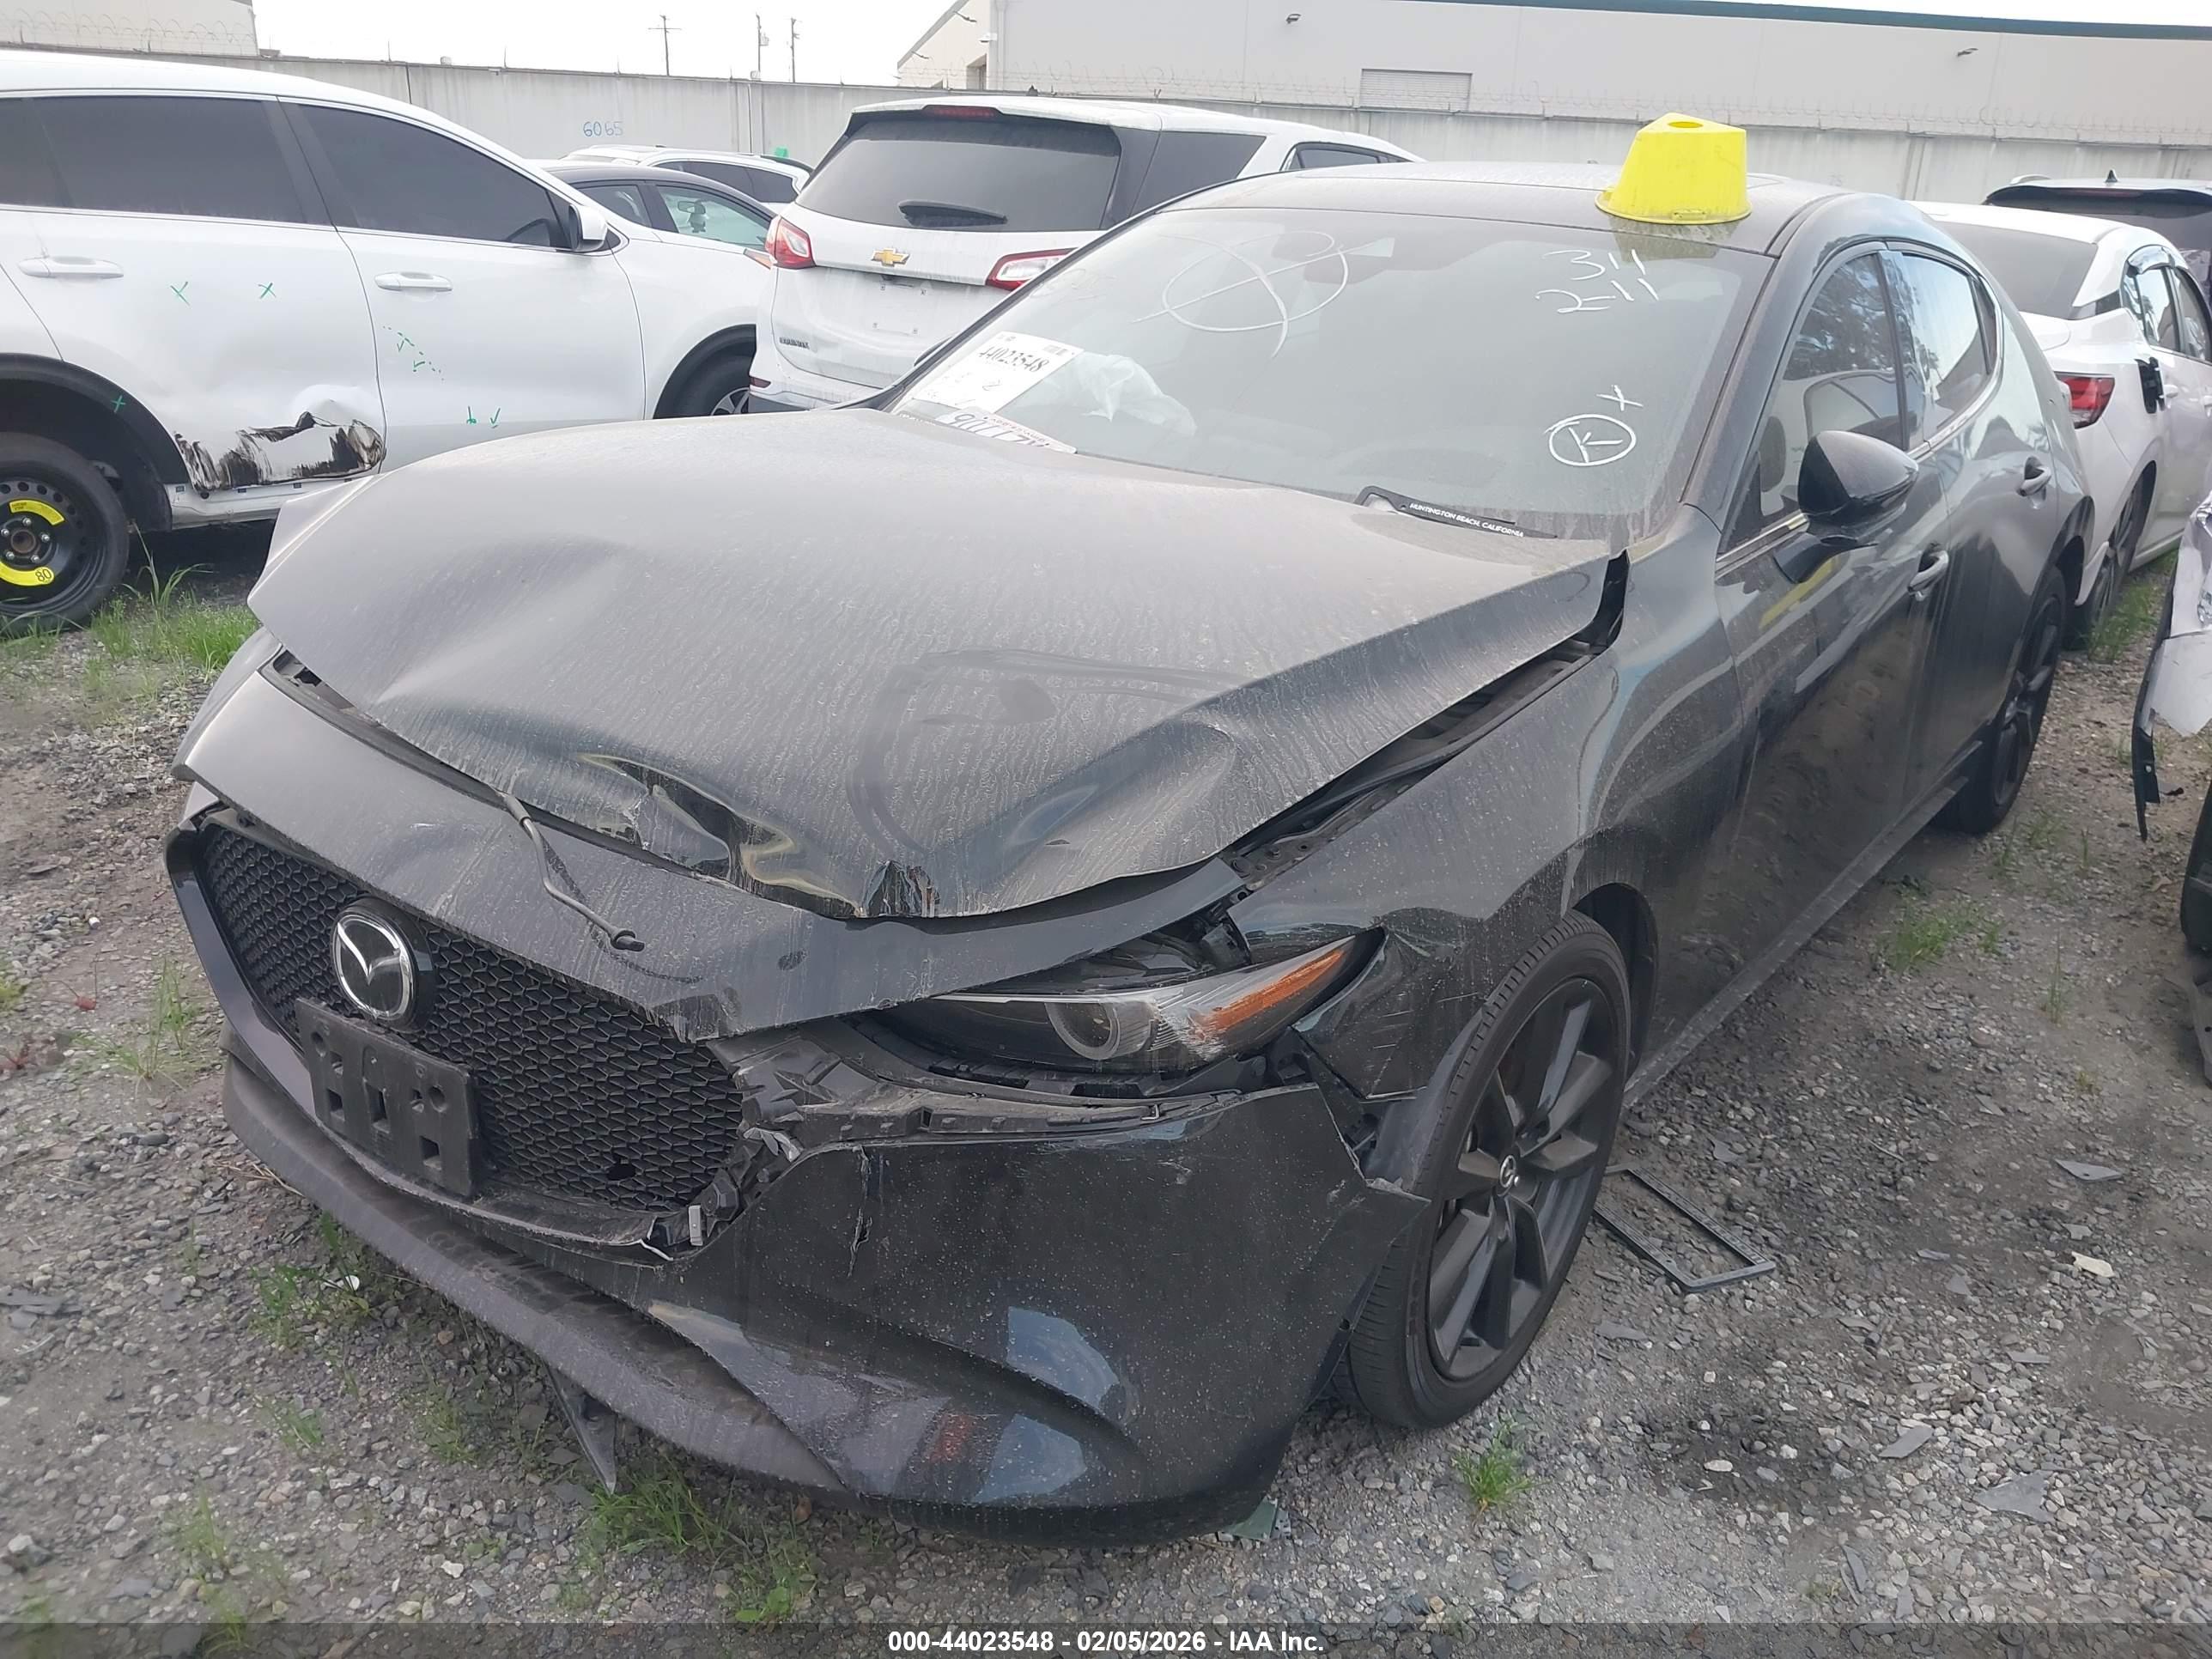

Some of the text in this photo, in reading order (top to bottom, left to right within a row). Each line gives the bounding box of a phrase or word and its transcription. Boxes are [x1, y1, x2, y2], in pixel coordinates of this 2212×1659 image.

[583, 121, 623, 137] 6065
[1409, 502, 1457, 520] HUNTINGTON
[1481, 522, 1524, 538] CALIFORNIA
[35, 568, 52, 582] 80
